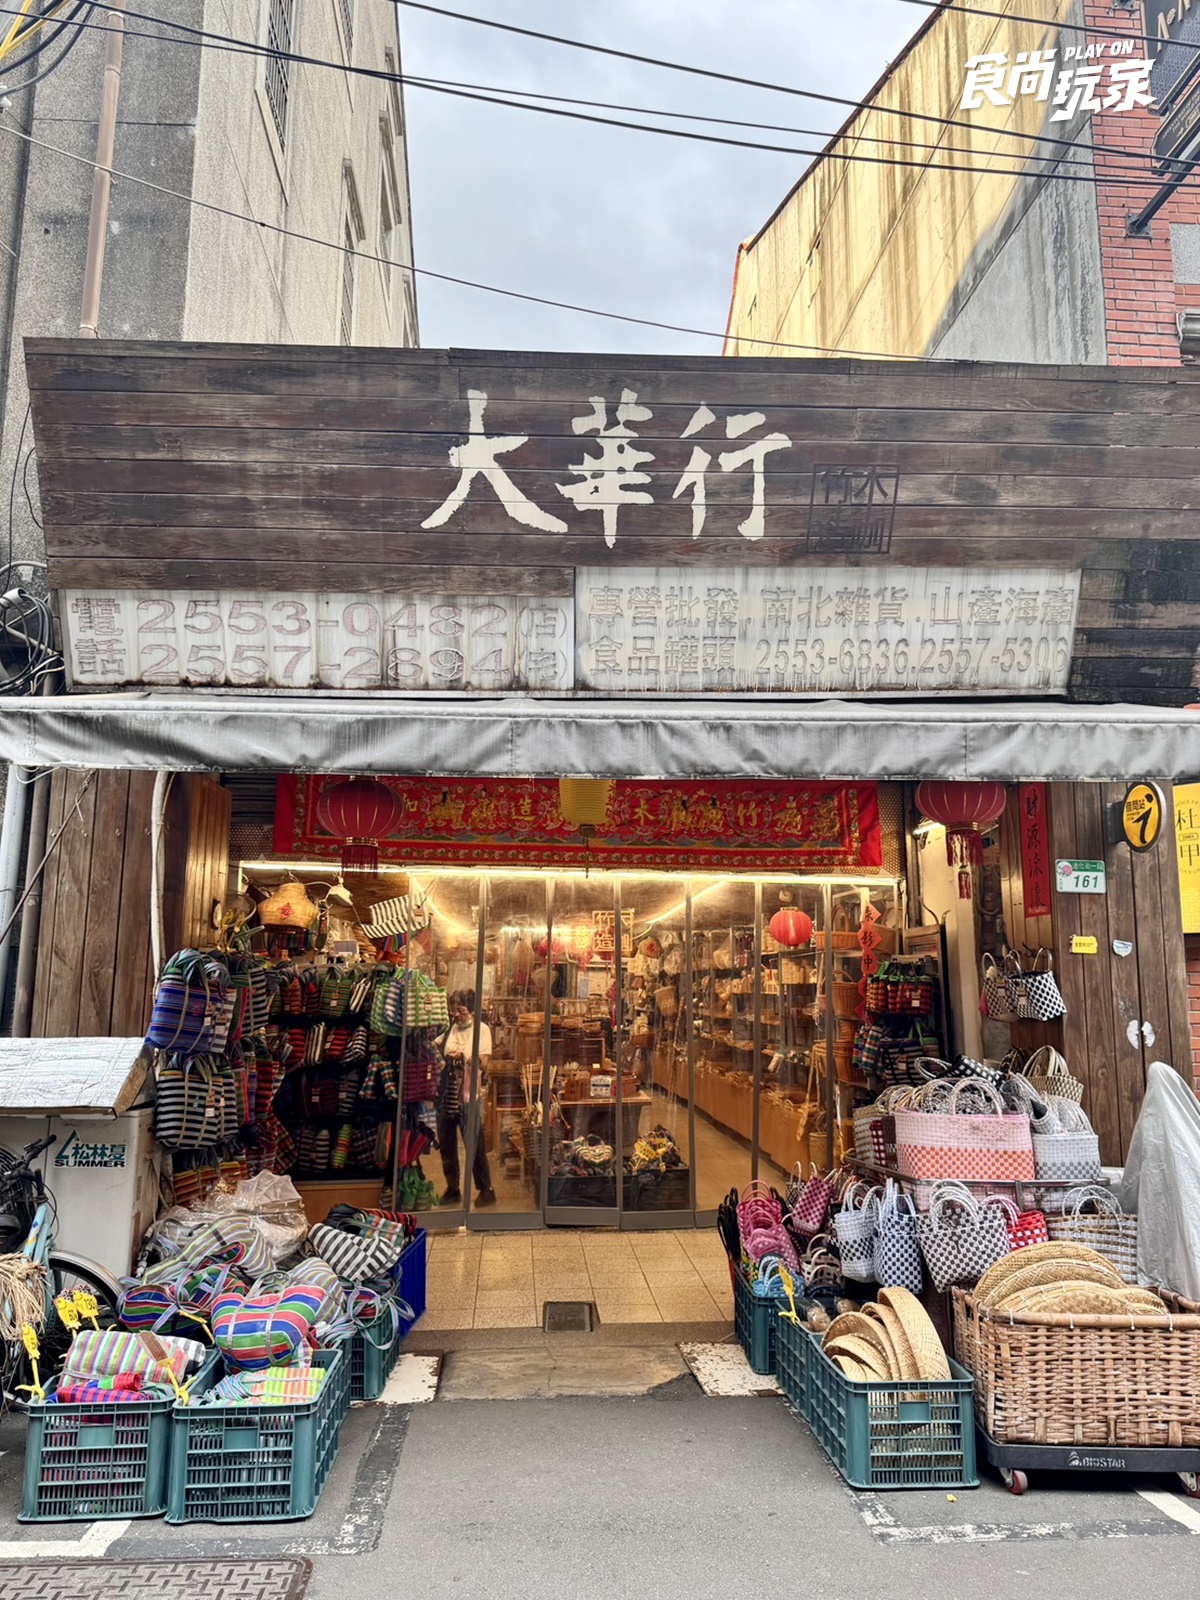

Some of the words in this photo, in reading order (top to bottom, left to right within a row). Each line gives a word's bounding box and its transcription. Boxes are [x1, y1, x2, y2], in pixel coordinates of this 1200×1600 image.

[421, 388, 793, 549] 大華行
[71, 597, 126, 676] 電話
[589, 635, 737, 677] 食品罐頭
[1074, 875, 1098, 888] 161
[54, 1160, 125, 1168] SUMMER
